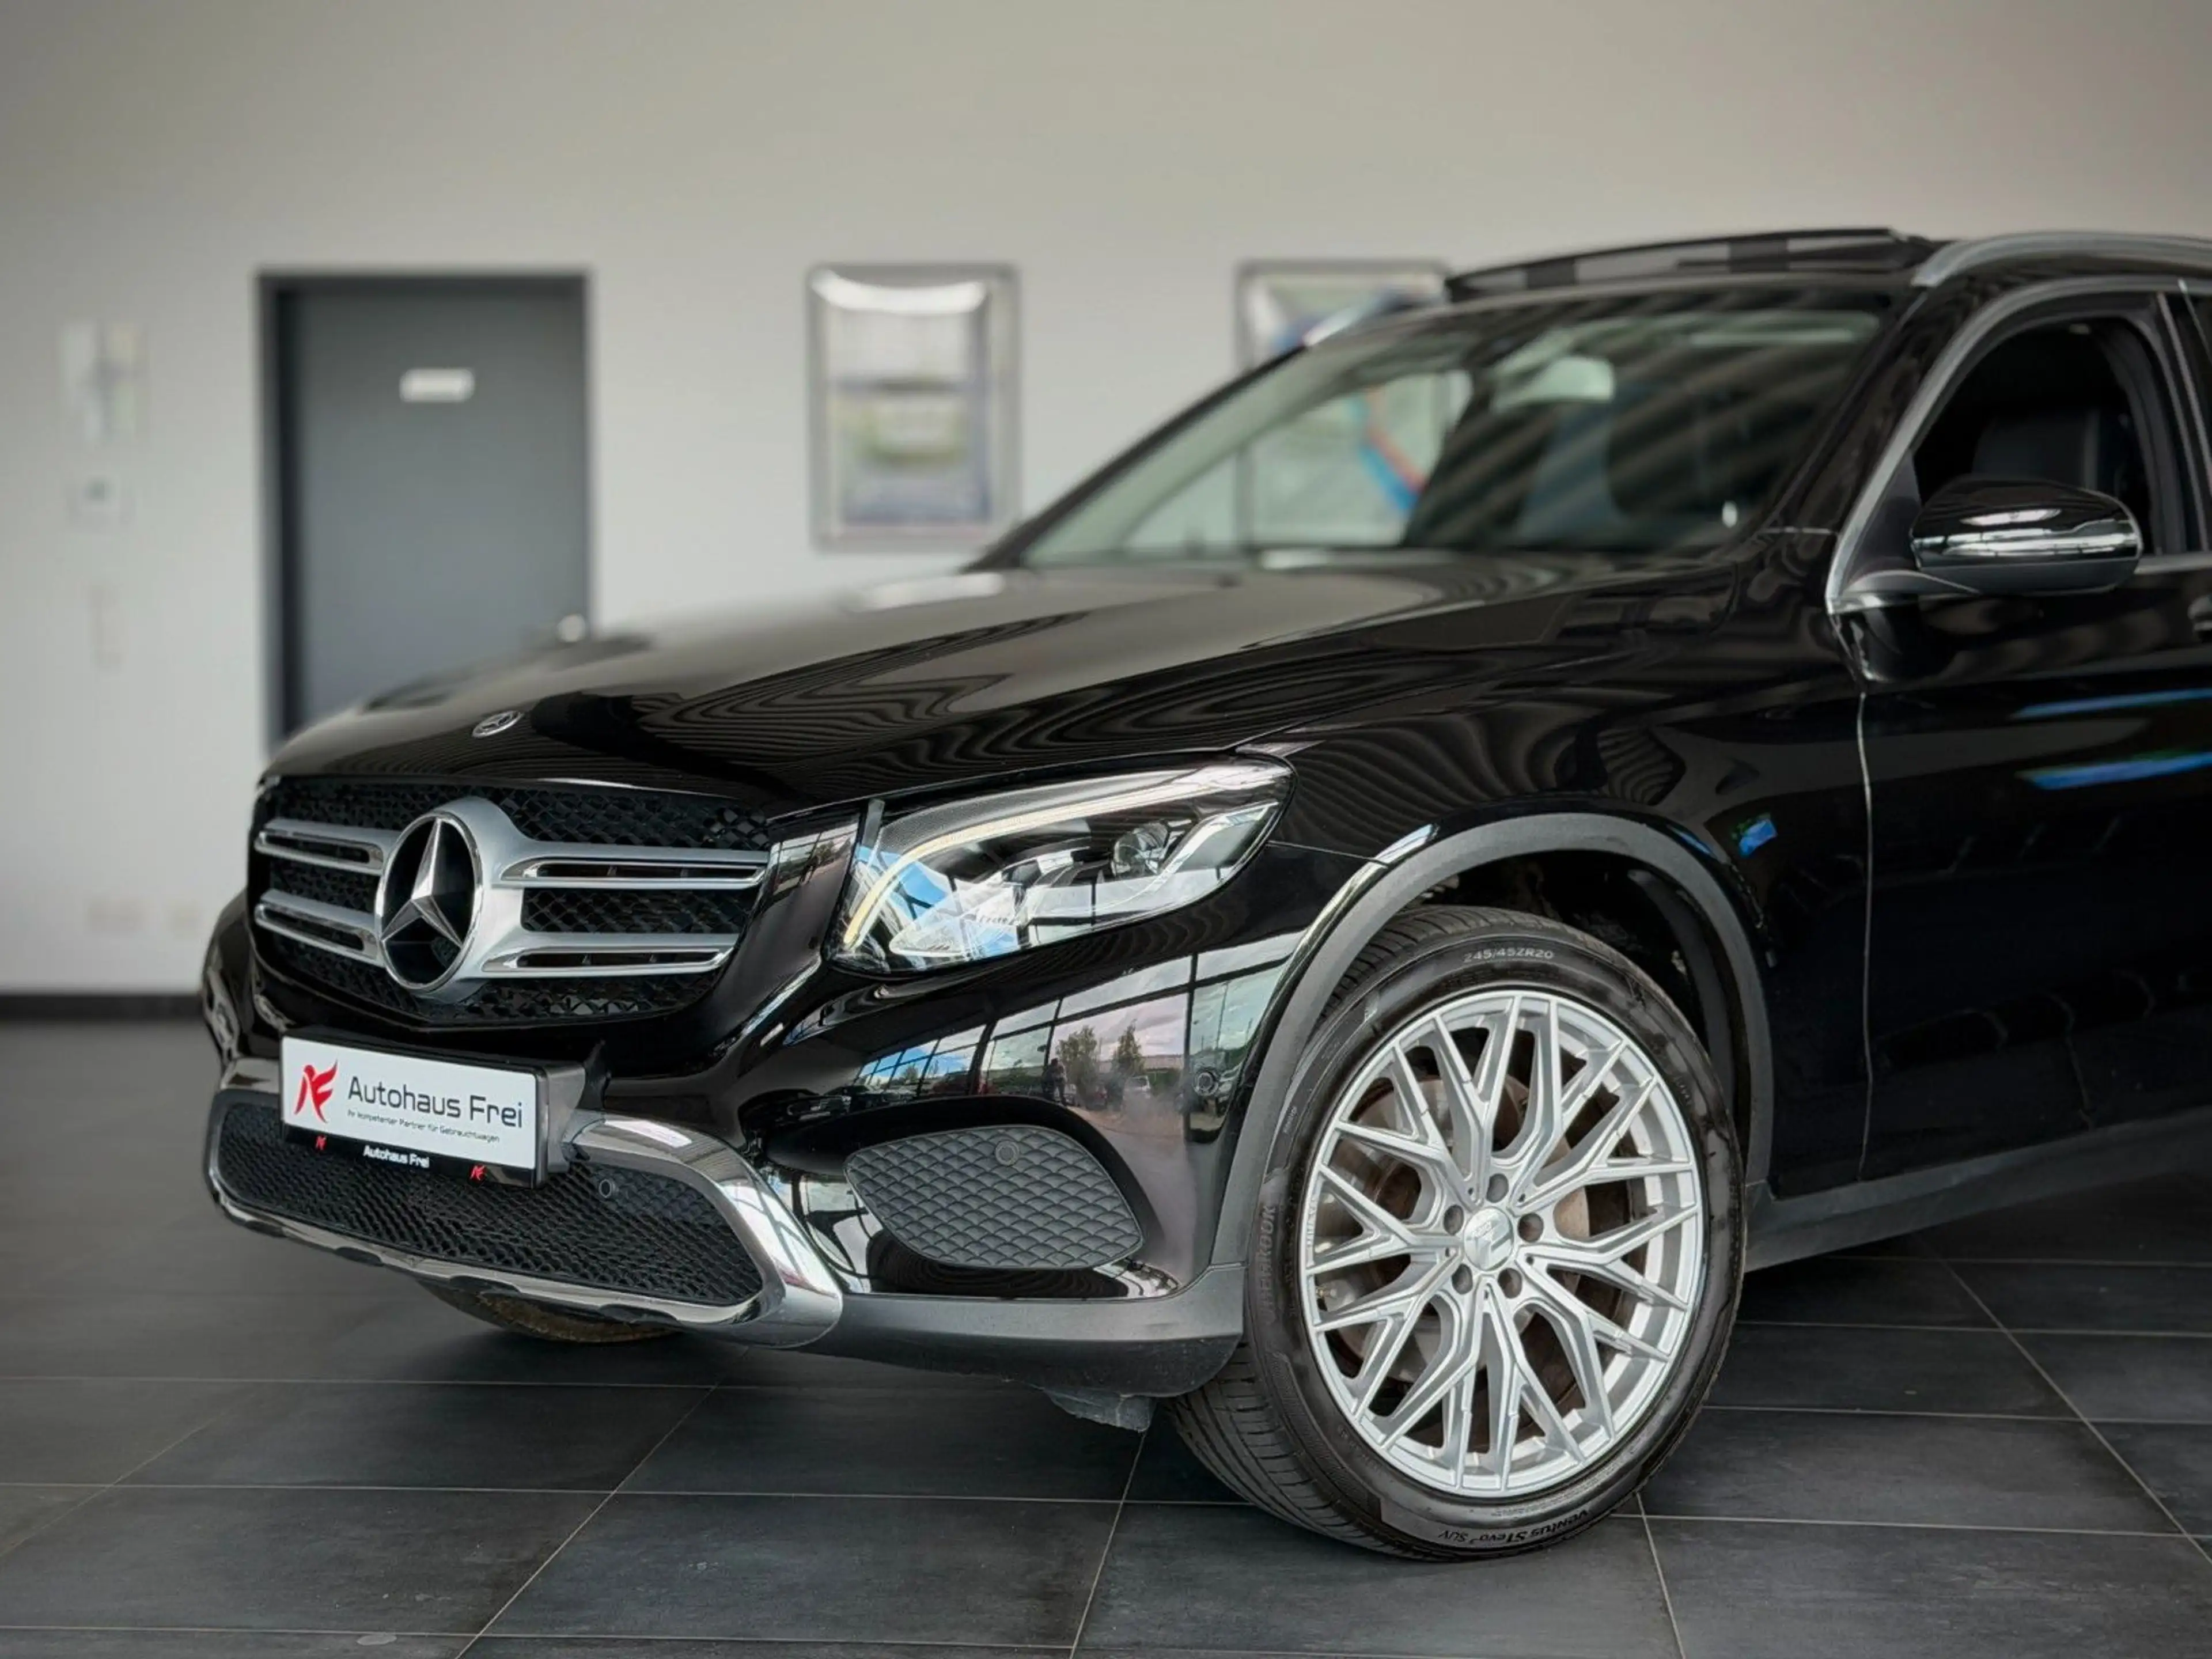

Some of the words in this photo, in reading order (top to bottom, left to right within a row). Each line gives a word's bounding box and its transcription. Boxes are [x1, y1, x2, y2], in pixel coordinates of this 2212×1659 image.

[347, 1075, 461, 1119] Autohaus
[469, 1094, 522, 1128] Frei
[399, 1118, 426, 1130] Partner
[363, 1145, 408, 1164] Autohaus
[409, 1153, 430, 1169] Frei
